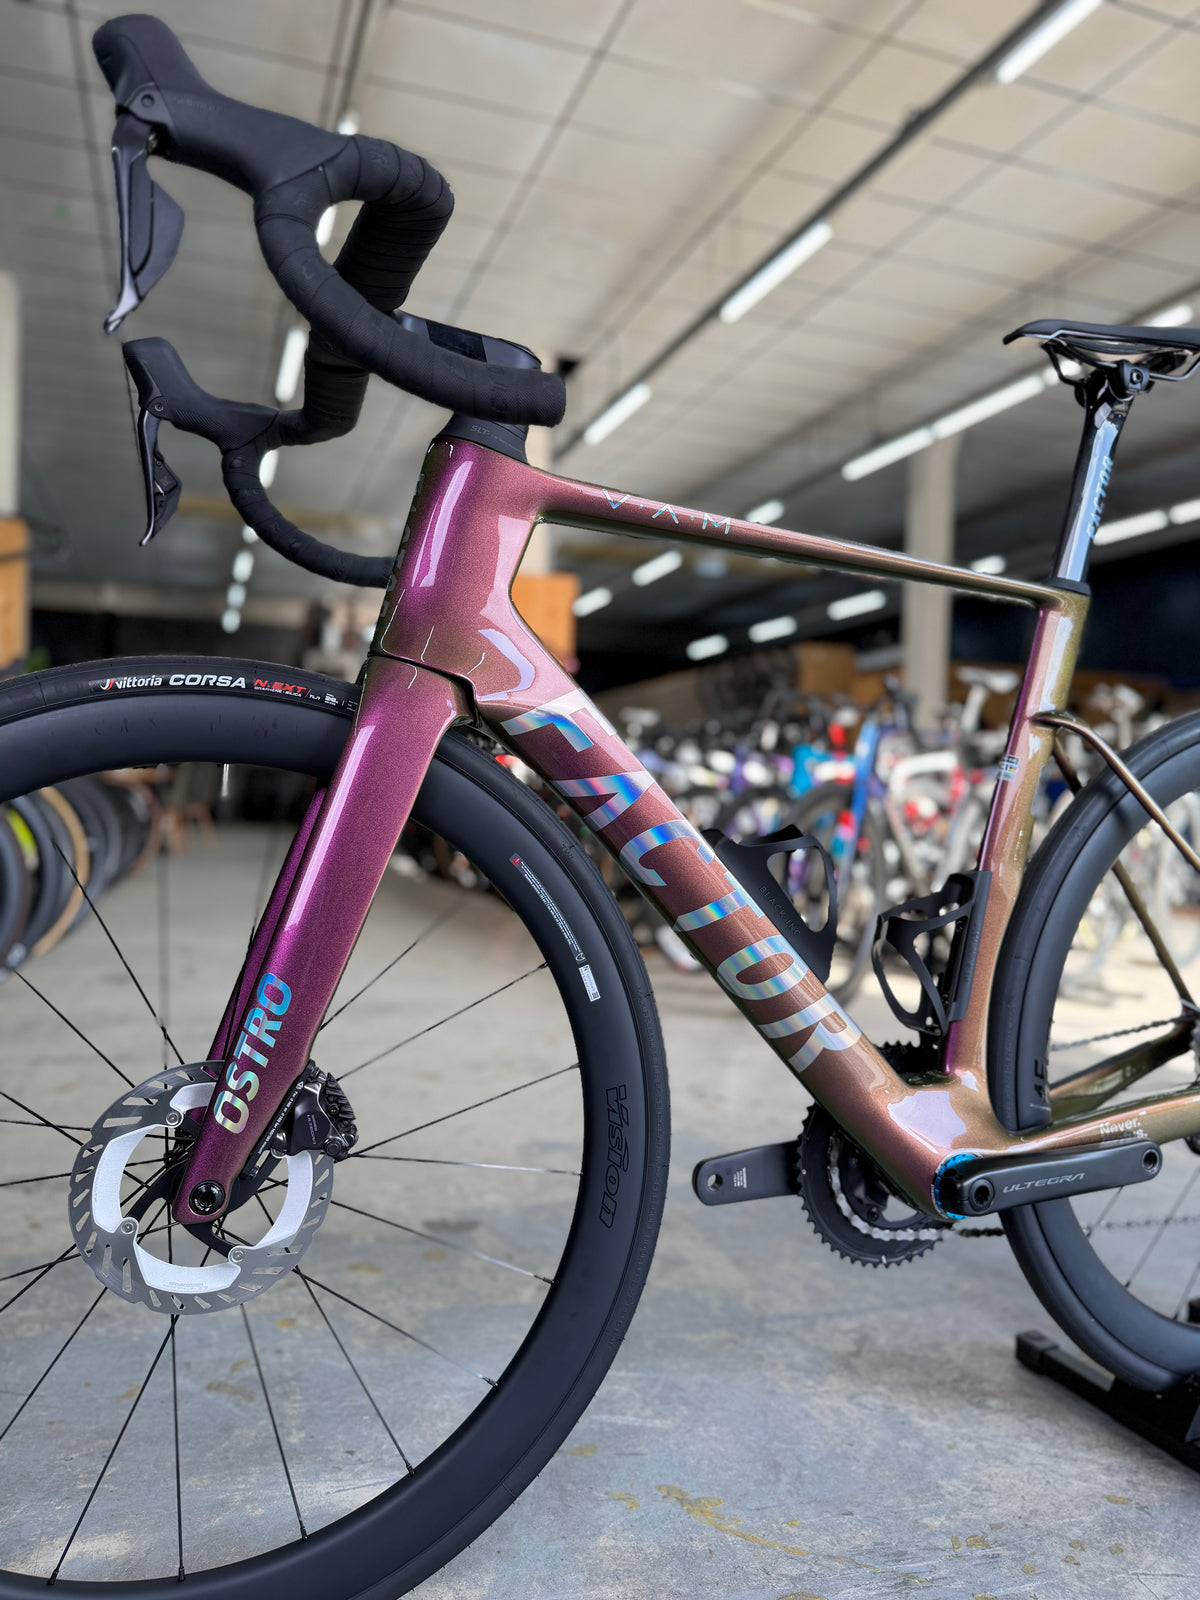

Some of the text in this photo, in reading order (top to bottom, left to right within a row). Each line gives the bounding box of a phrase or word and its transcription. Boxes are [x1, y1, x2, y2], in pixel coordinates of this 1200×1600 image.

[168, 674, 246, 688] CORSA
[500, 688, 861, 1073] FACTOR
[213, 972, 292, 1134] OSTRO
[599, 1083, 630, 1229] Vision
[1002, 1172, 1086, 1194] ULTEGRA
